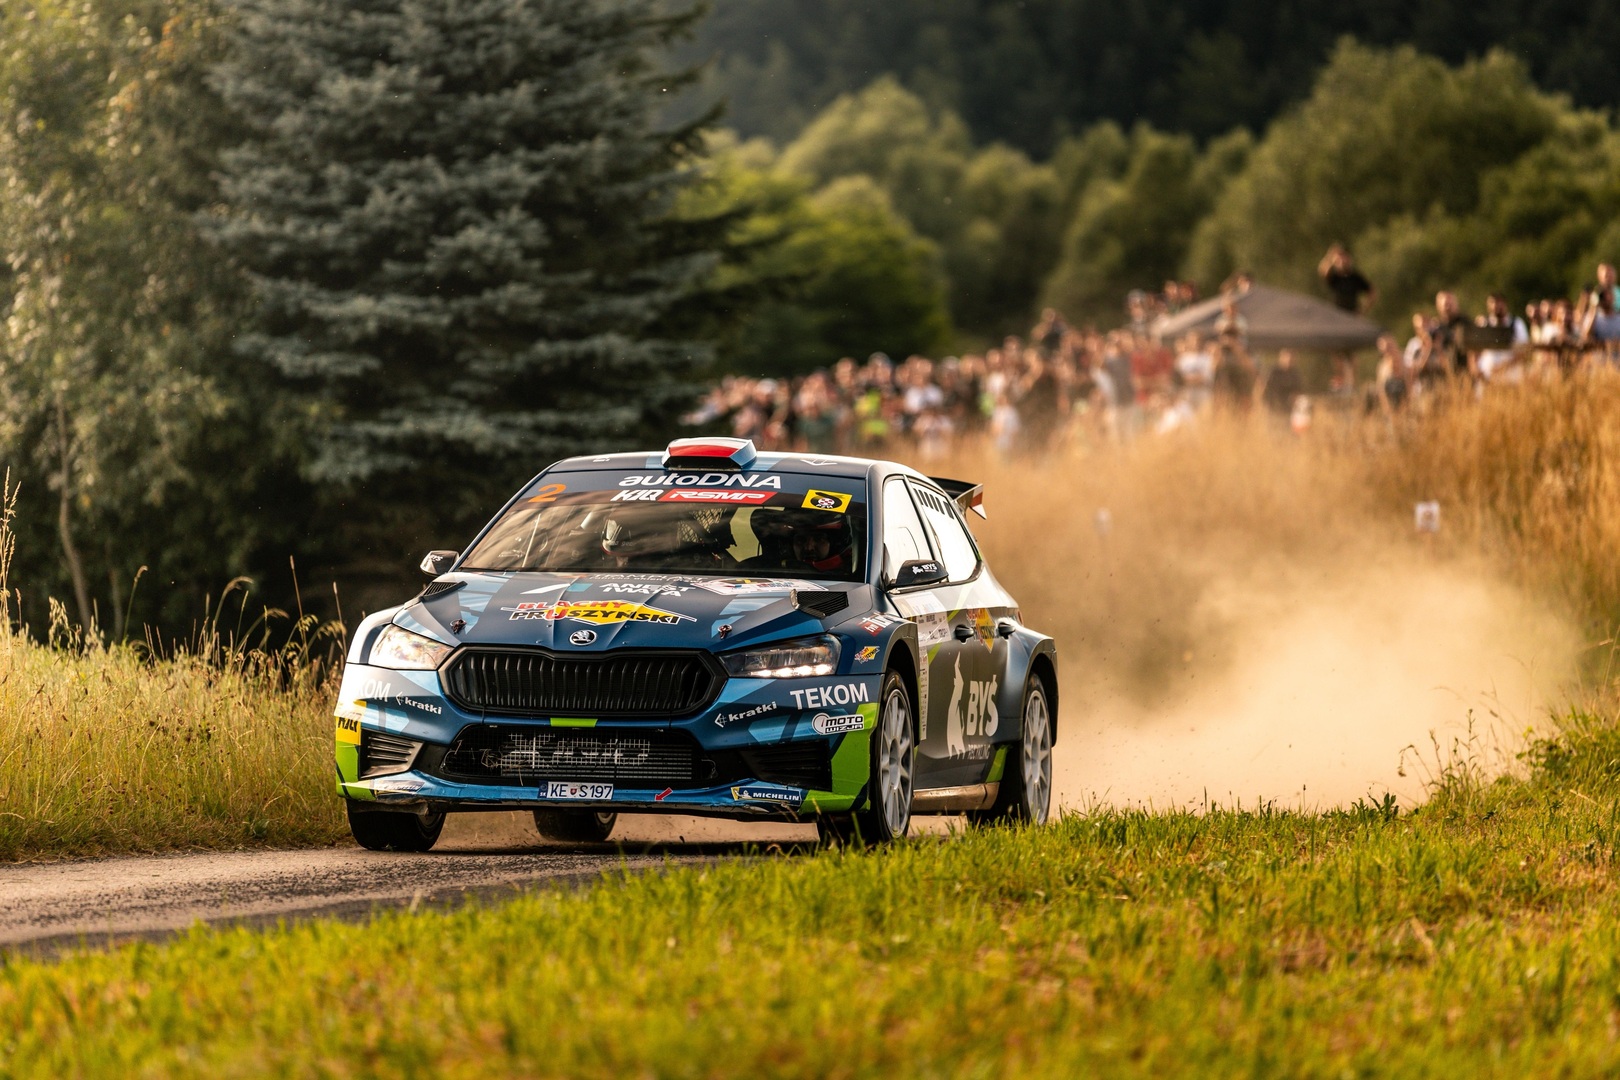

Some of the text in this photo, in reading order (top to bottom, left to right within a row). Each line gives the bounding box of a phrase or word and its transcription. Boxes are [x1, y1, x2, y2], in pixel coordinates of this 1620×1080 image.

[618, 473, 782, 489] autoDNA
[527, 483, 567, 503] 2
[669, 491, 766, 500] RSMP
[516, 601, 626, 610] BLACHY
[509, 608, 681, 625] PRUSZYŃSKI
[789, 682, 870, 711] TEKOM
[404, 697, 442, 715] kratki
[728, 701, 777, 723] kratki
[825, 715, 864, 727] MOTO
[825, 725, 863, 733] WIZJA
[550, 783, 613, 799] KE S197
[752, 792, 800, 801] MICHELIN
